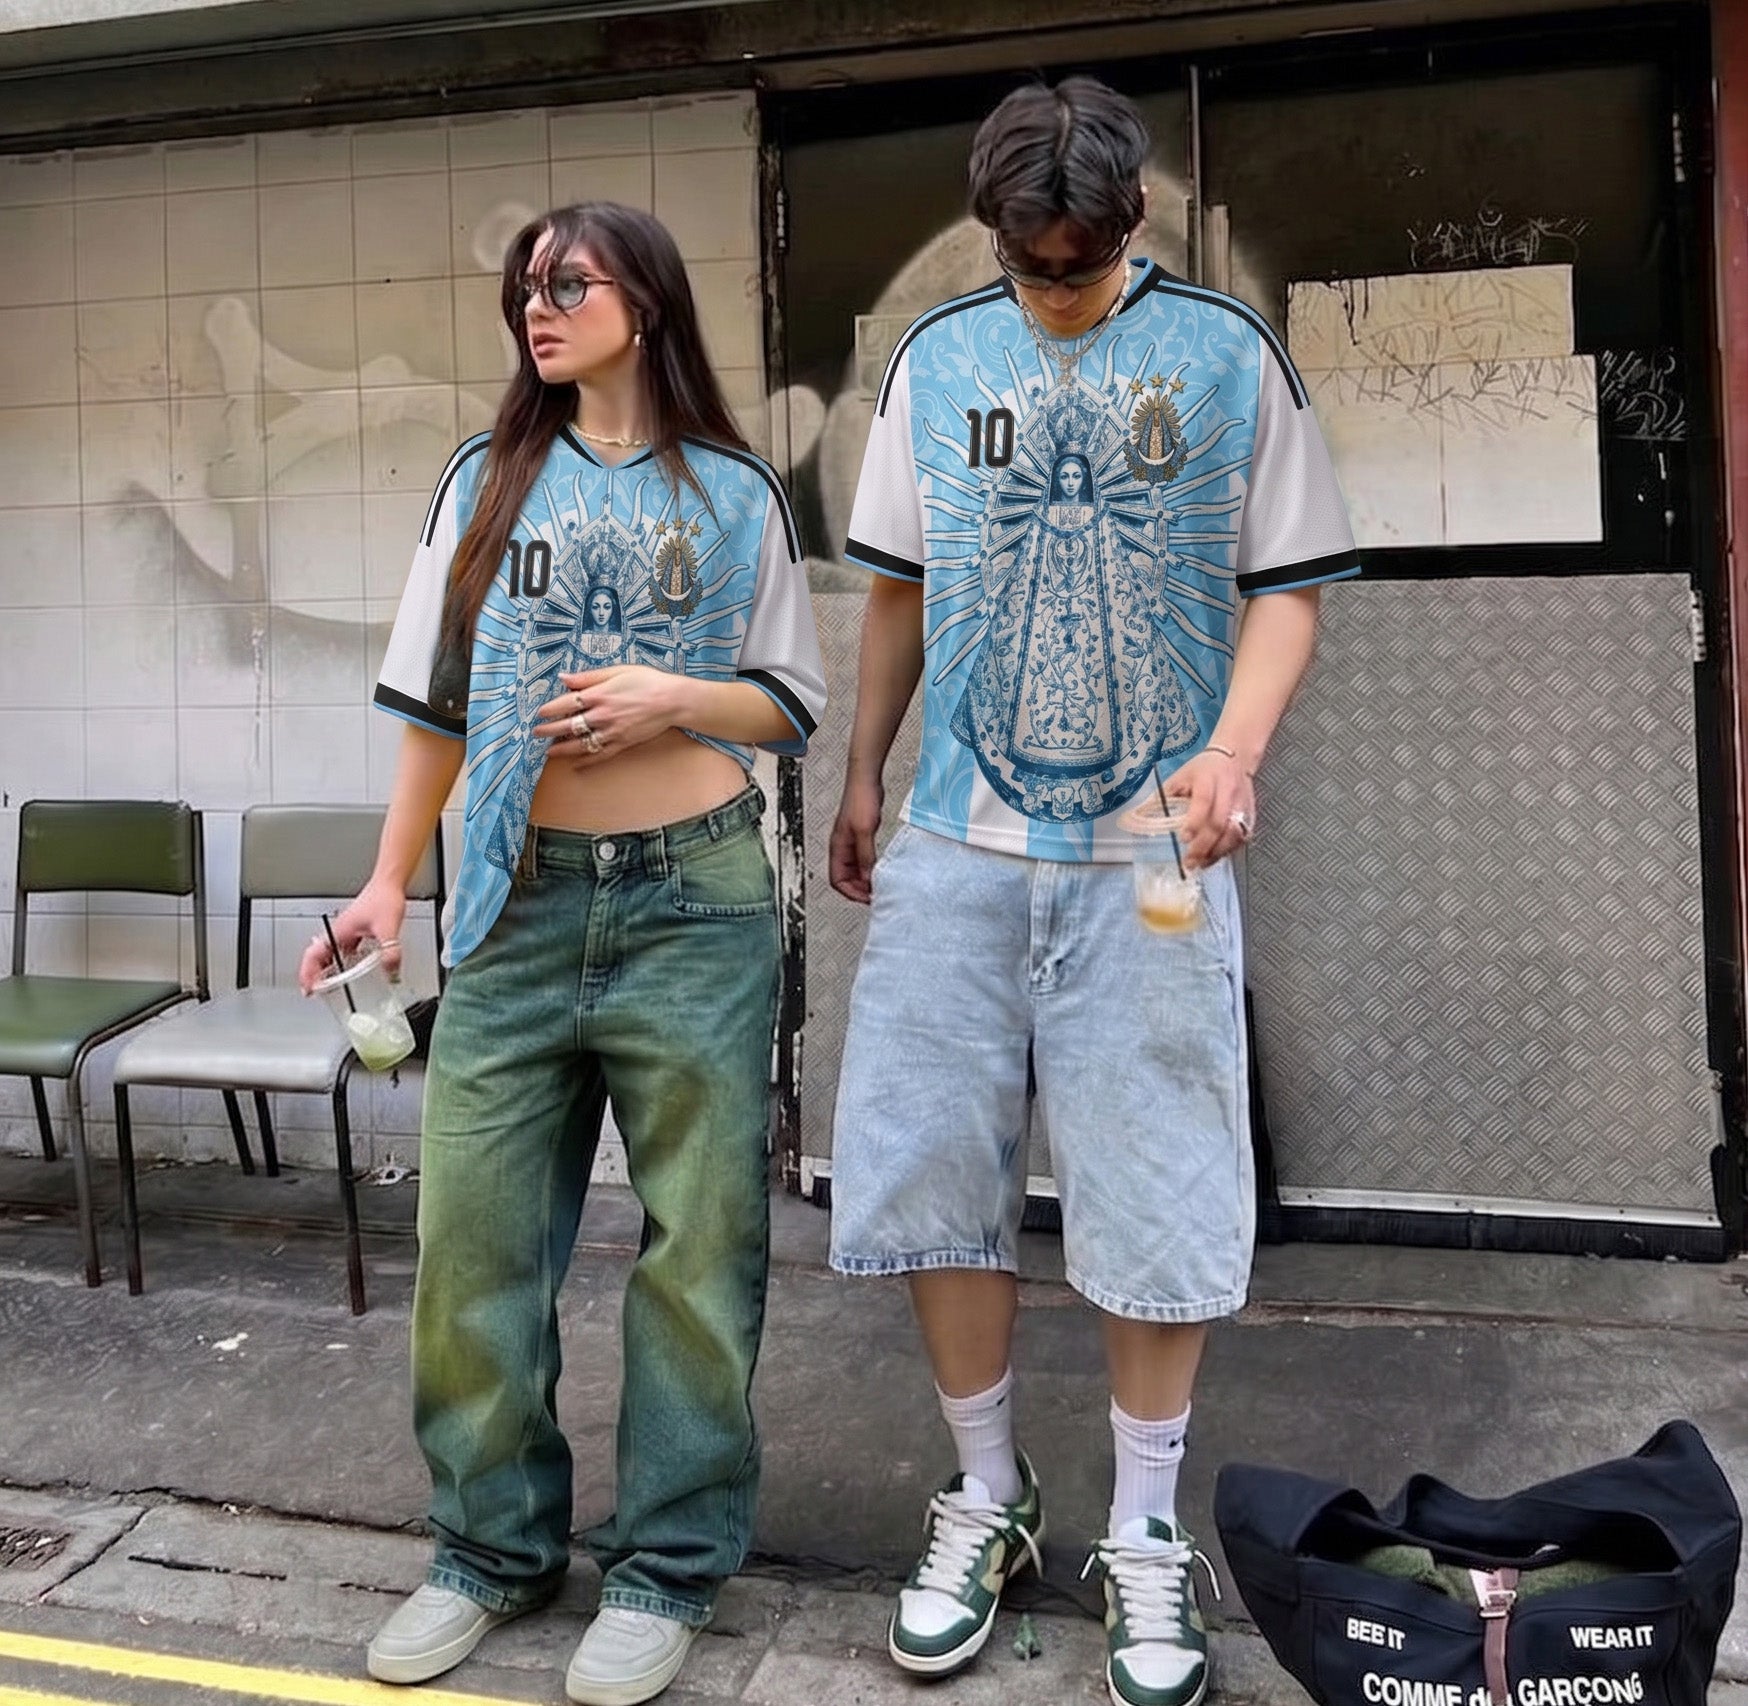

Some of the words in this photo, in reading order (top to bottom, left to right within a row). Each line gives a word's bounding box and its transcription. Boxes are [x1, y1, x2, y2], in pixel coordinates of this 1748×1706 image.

[966, 407, 1015, 469] 10
[507, 539, 552, 599] 10
[1387, 1627, 1406, 1651] IT
[1569, 1626, 1635, 1649] WEAR
[1634, 1625, 1654, 1647] IT
[1363, 1672, 1462, 1706] COMME
